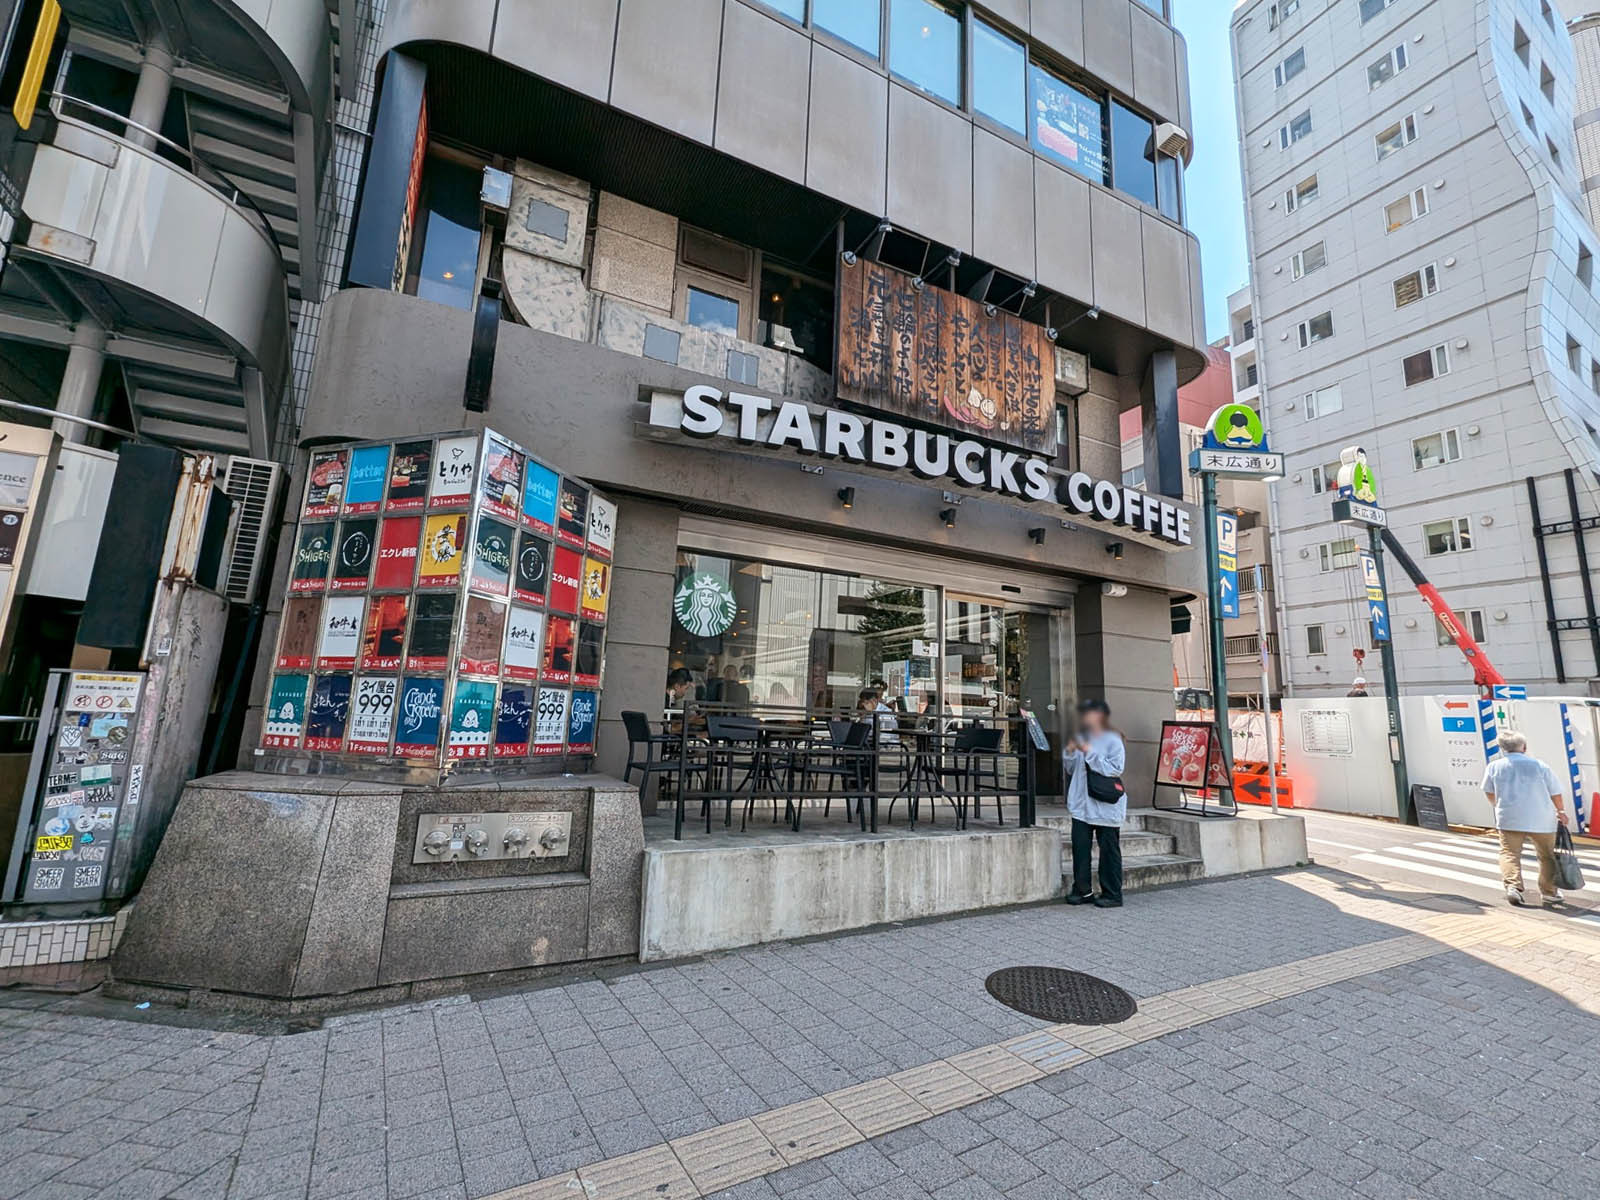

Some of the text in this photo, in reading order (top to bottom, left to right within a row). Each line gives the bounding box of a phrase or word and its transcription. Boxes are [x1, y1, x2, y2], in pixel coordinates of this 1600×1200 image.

[439, 461, 473, 478] とりや
[681, 384, 1052, 503] STARBUCKS
[1067, 471, 1192, 545] COFFEE
[1207, 454, 1277, 470] 末広通り
[1352, 505, 1384, 522] 末広通り
[1222, 519, 1233, 541] P
[380, 547, 417, 558] エクレ新宿
[1366, 559, 1375, 577] P
[360, 680, 395, 694] タイ屋台
[358, 693, 393, 714] 999
[538, 703, 564, 721] 999
[1456, 719, 1465, 728] P
